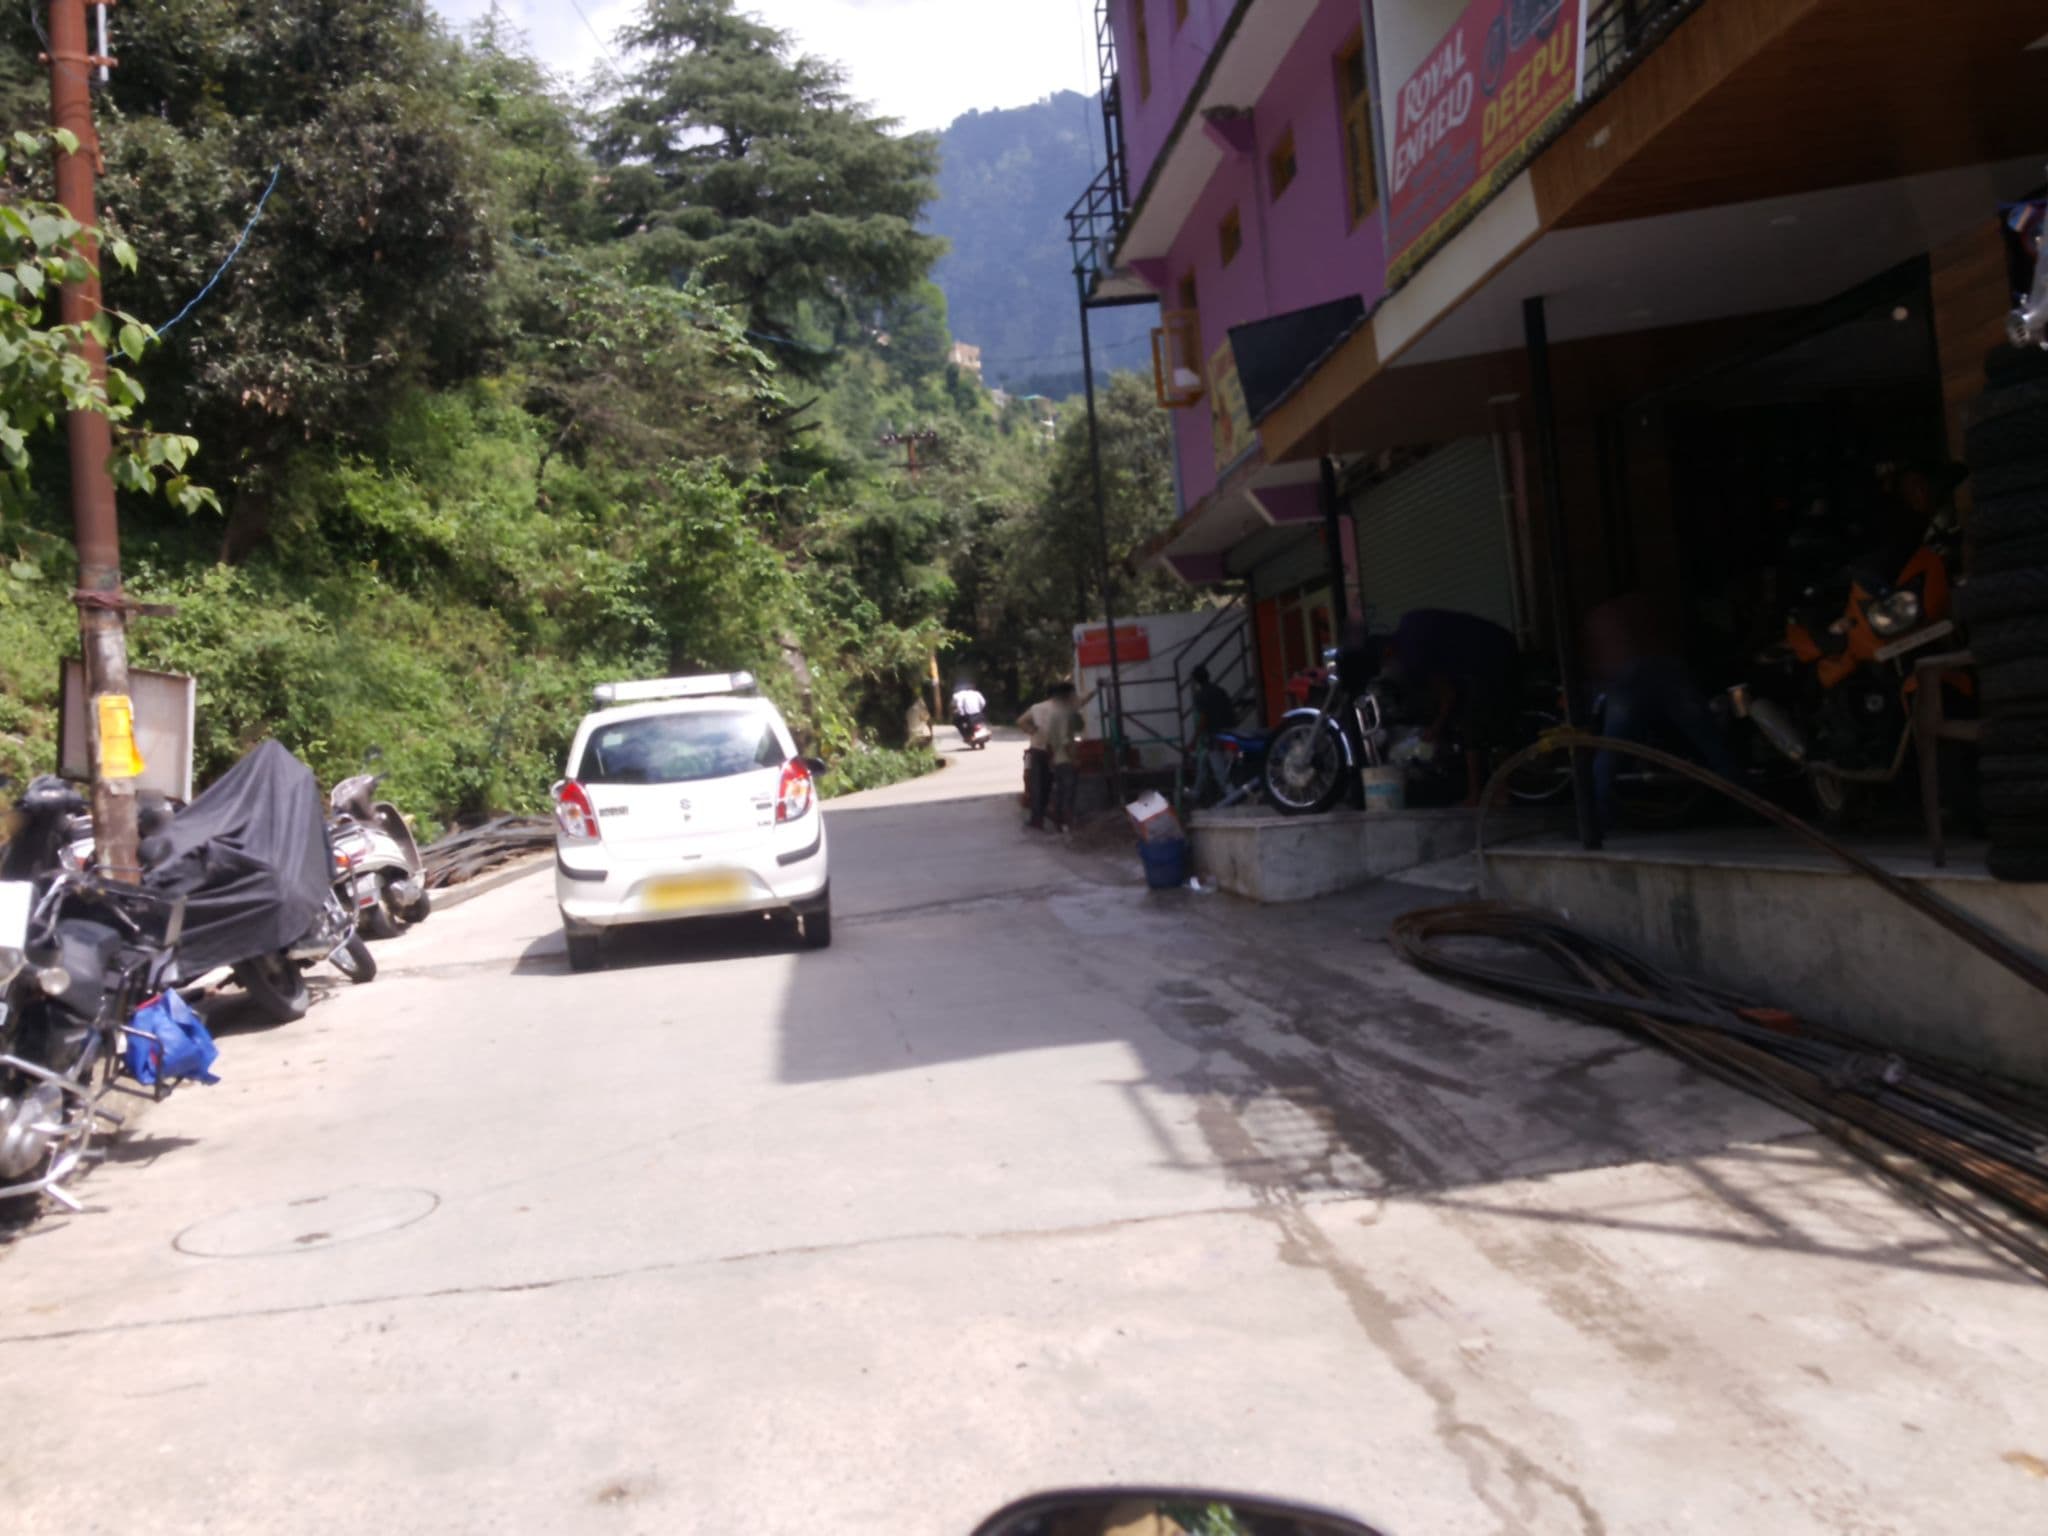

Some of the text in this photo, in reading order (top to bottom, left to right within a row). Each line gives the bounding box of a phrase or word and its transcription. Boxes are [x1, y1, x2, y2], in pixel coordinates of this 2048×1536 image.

[1394, 72, 1473, 193] ENFIELD
[1402, 28, 1466, 133] ROYAL
[1482, 20, 1571, 148] DEEPU
